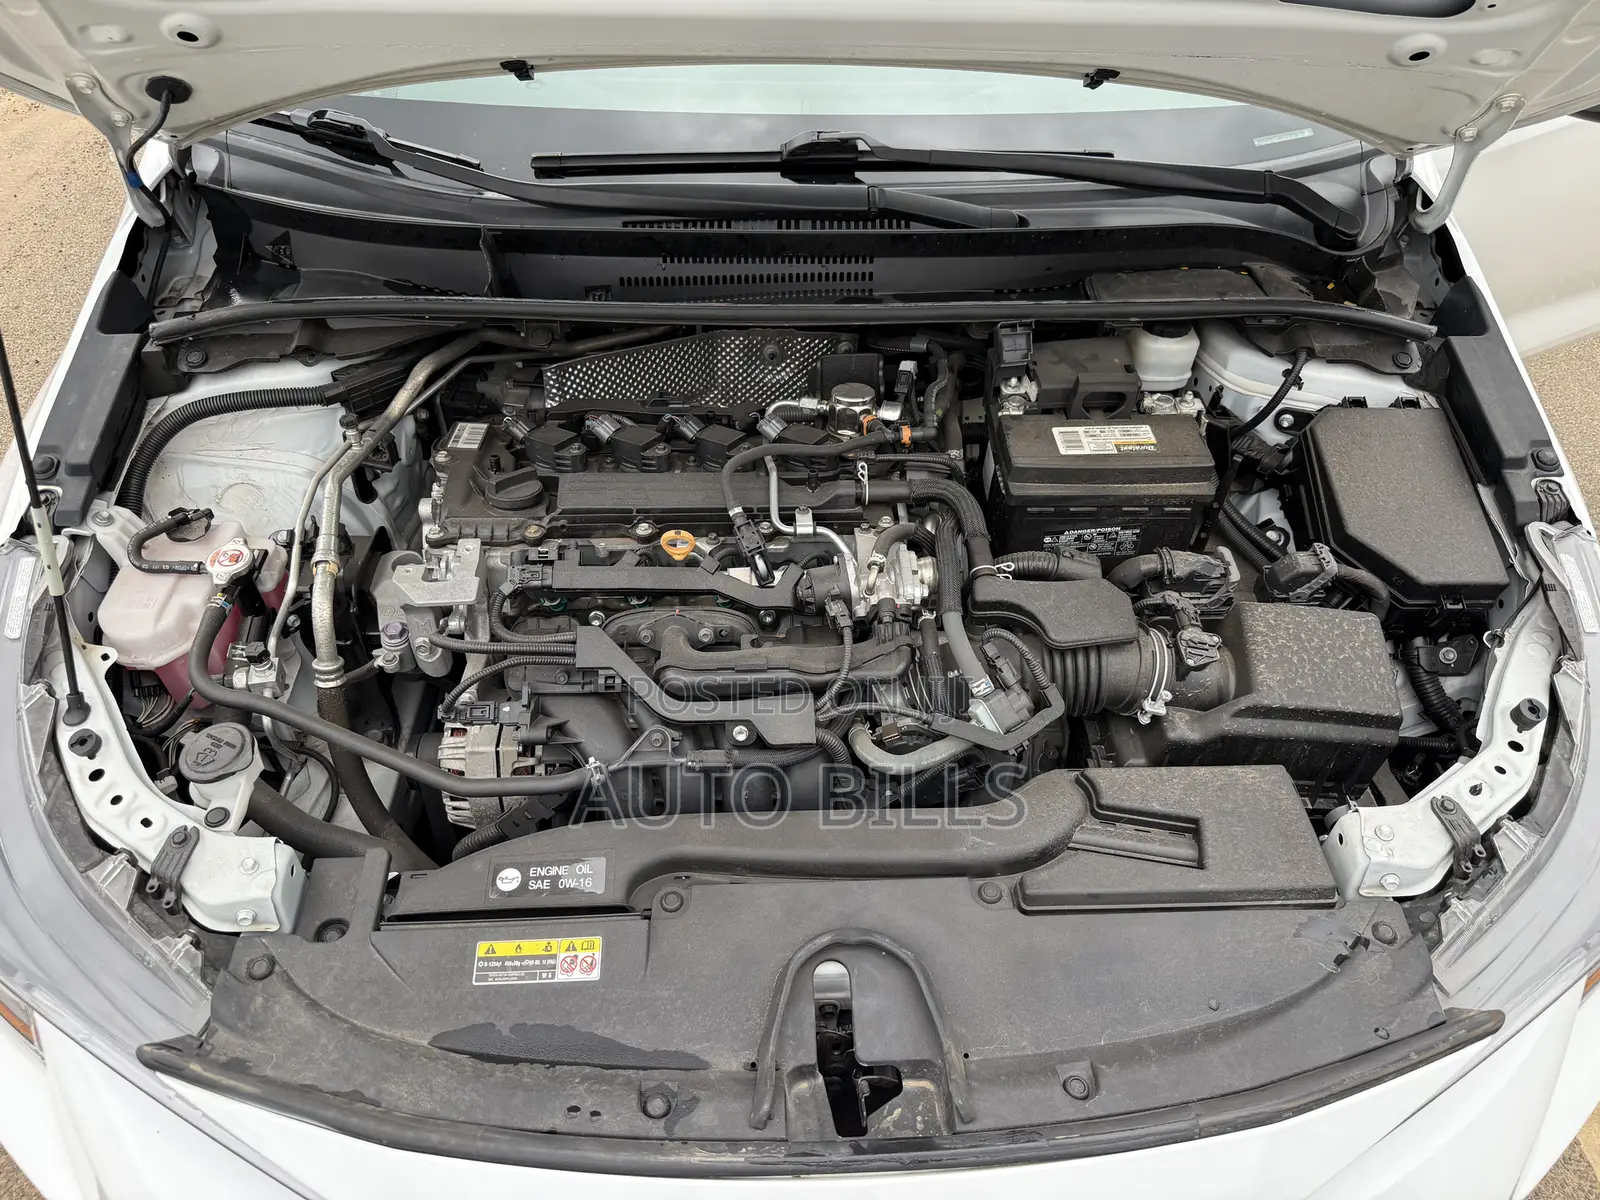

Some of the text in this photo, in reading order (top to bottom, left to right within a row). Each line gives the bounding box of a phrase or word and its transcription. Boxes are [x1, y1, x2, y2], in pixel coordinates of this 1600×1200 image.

[1120, 443, 1157, 452] Duralast
[529, 864, 594, 877] ENGINE OIL
[528, 878, 593, 890] SAE 0W-16
